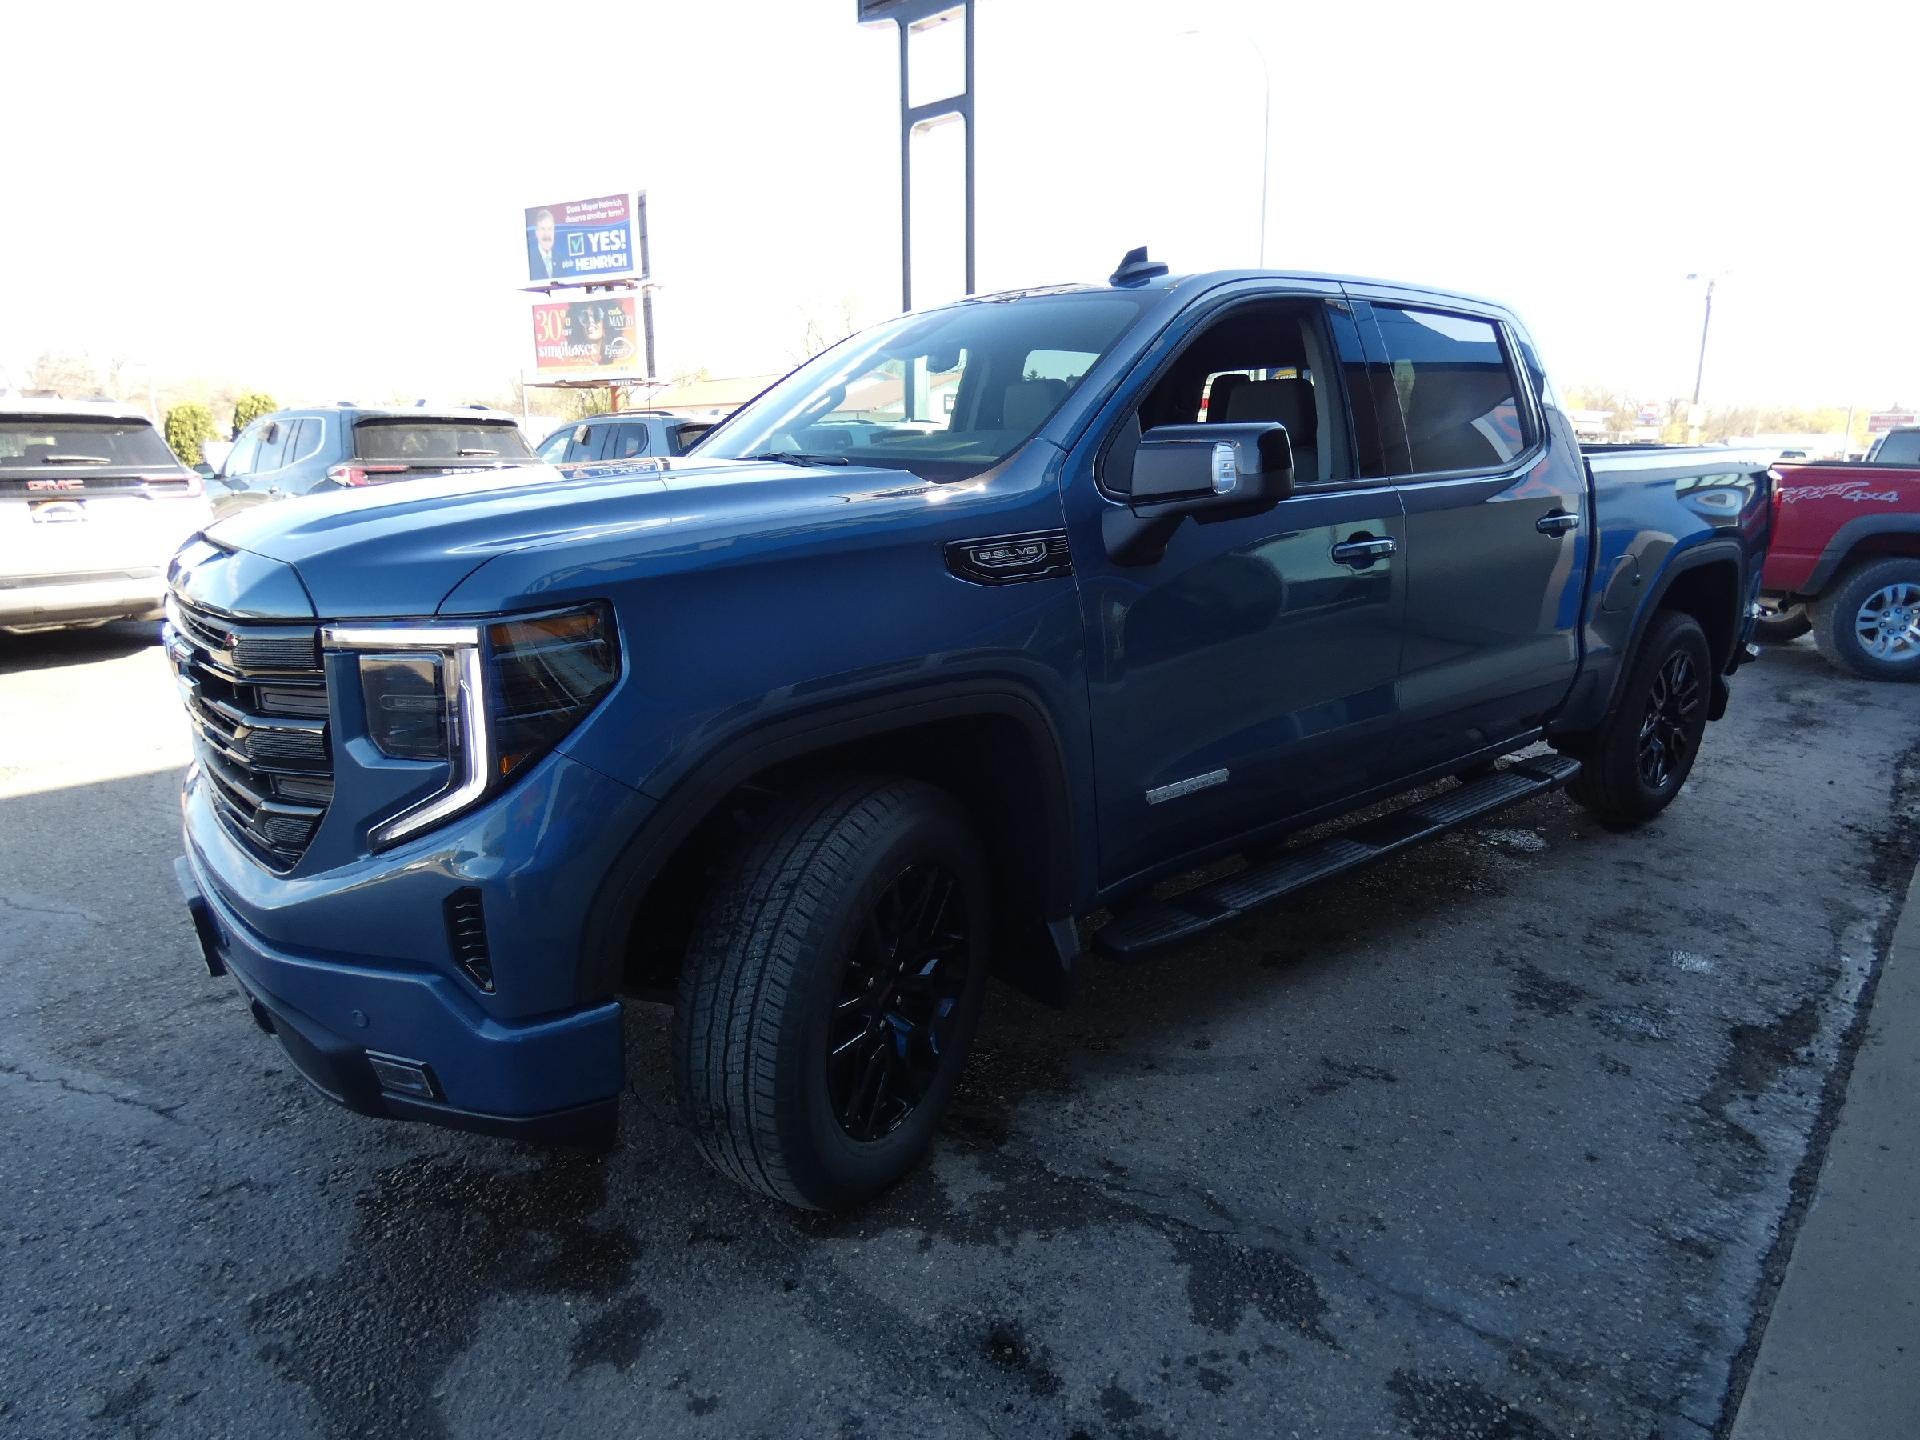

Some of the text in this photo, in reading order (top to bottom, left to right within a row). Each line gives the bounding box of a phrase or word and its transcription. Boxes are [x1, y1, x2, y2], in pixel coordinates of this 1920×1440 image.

[598, 199, 622, 208] Heinrich
[587, 229, 627, 253] YES!
[575, 253, 627, 272] HEINRICH
[28, 479, 85, 491] GMC
